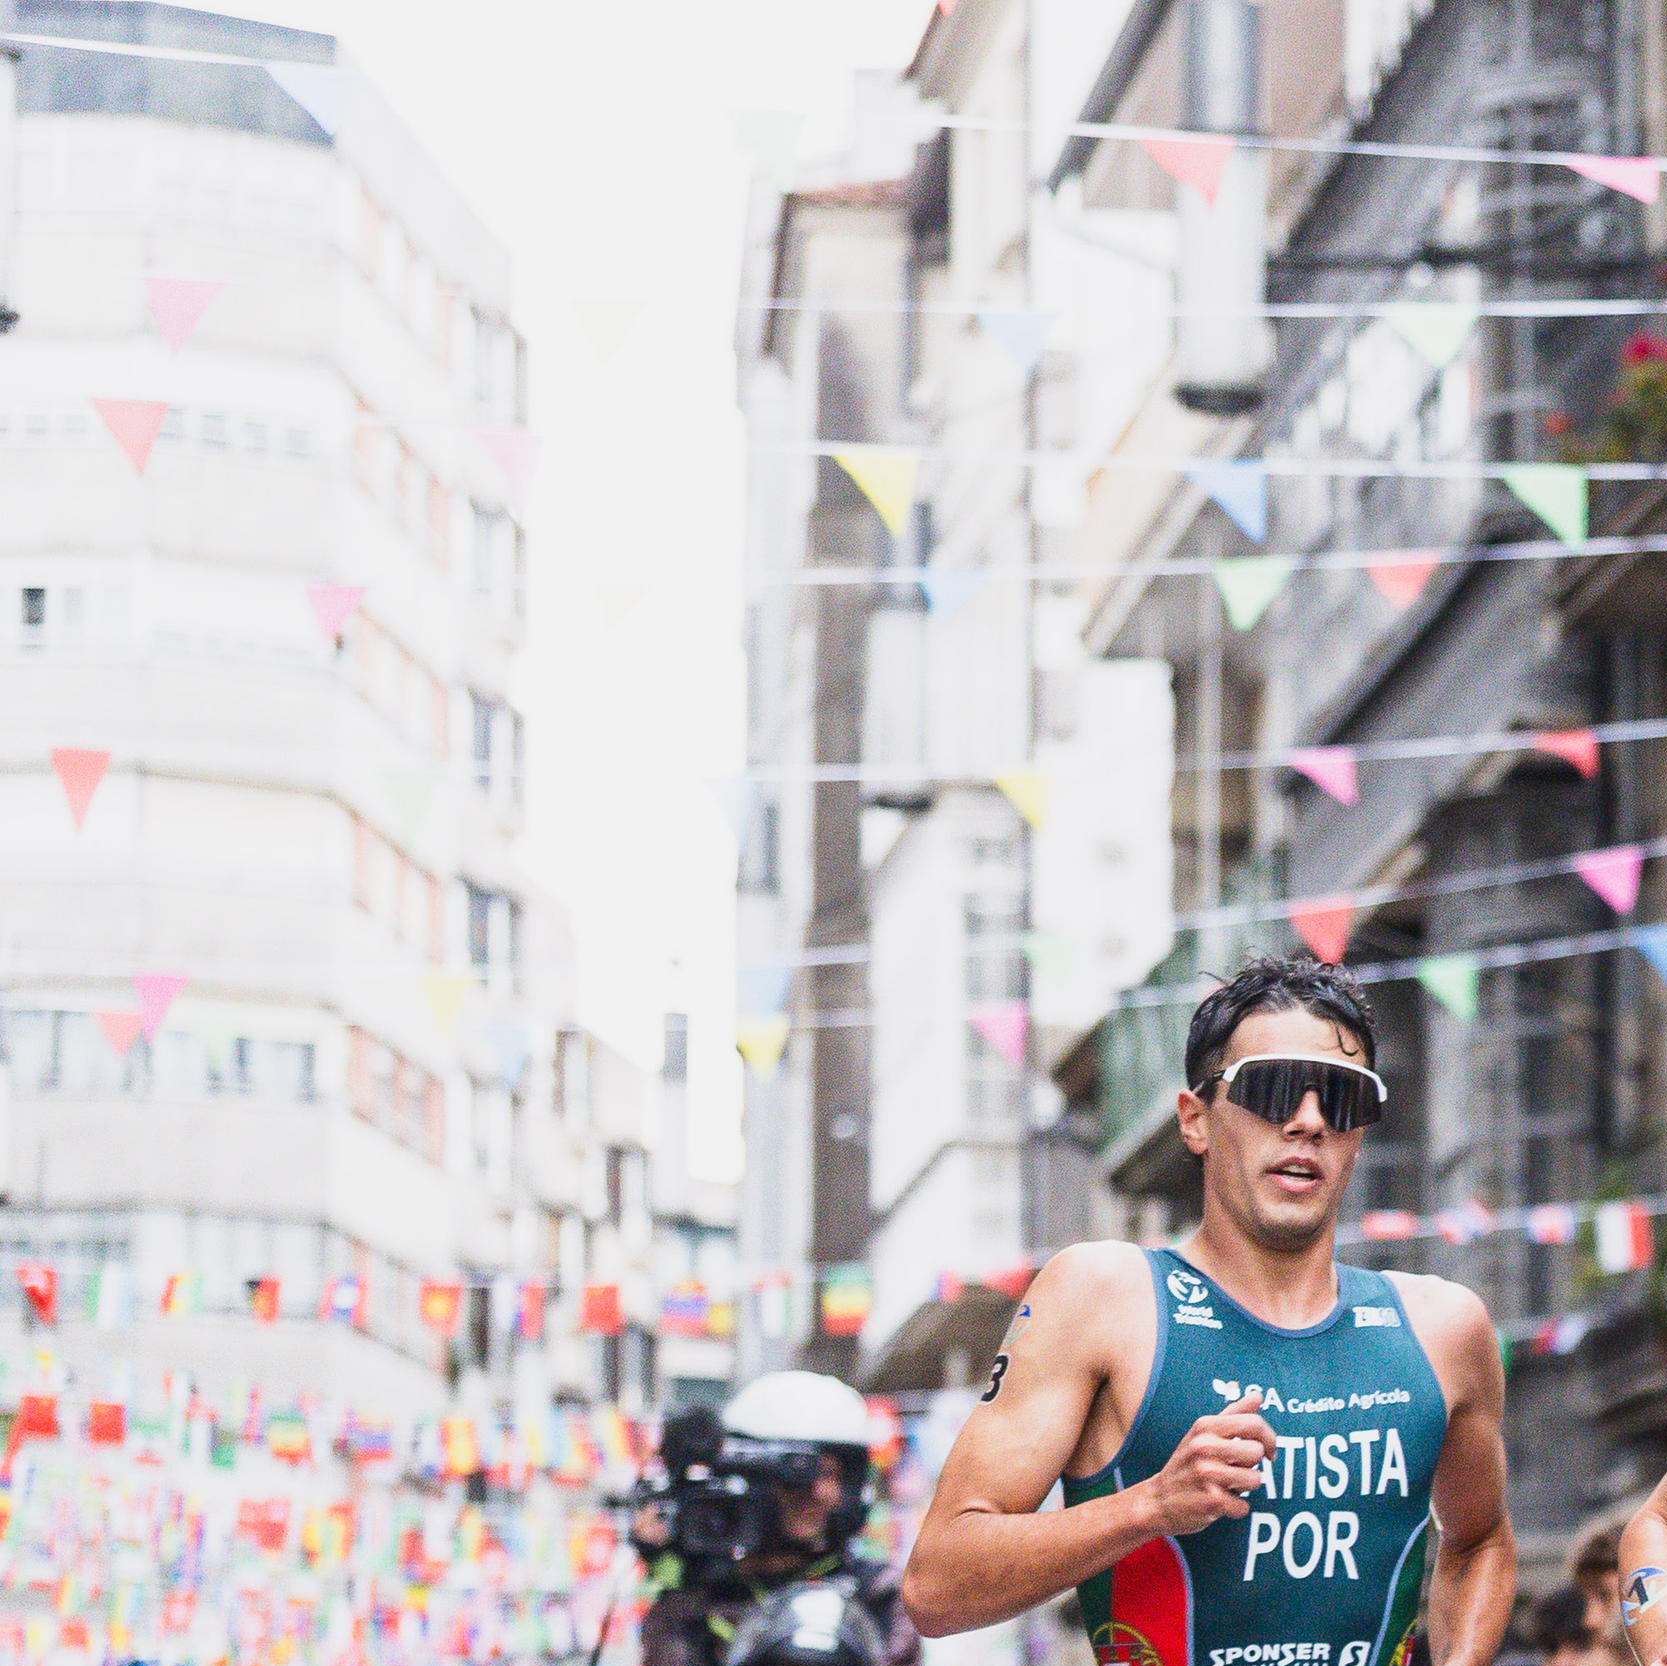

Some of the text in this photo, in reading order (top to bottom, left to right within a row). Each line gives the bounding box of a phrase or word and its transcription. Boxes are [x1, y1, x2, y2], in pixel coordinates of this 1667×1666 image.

[1286, 1396, 1346, 1414] Crédito
[1234, 1428, 1410, 1499] ATISTA
[1243, 1510, 1360, 1582] POR
